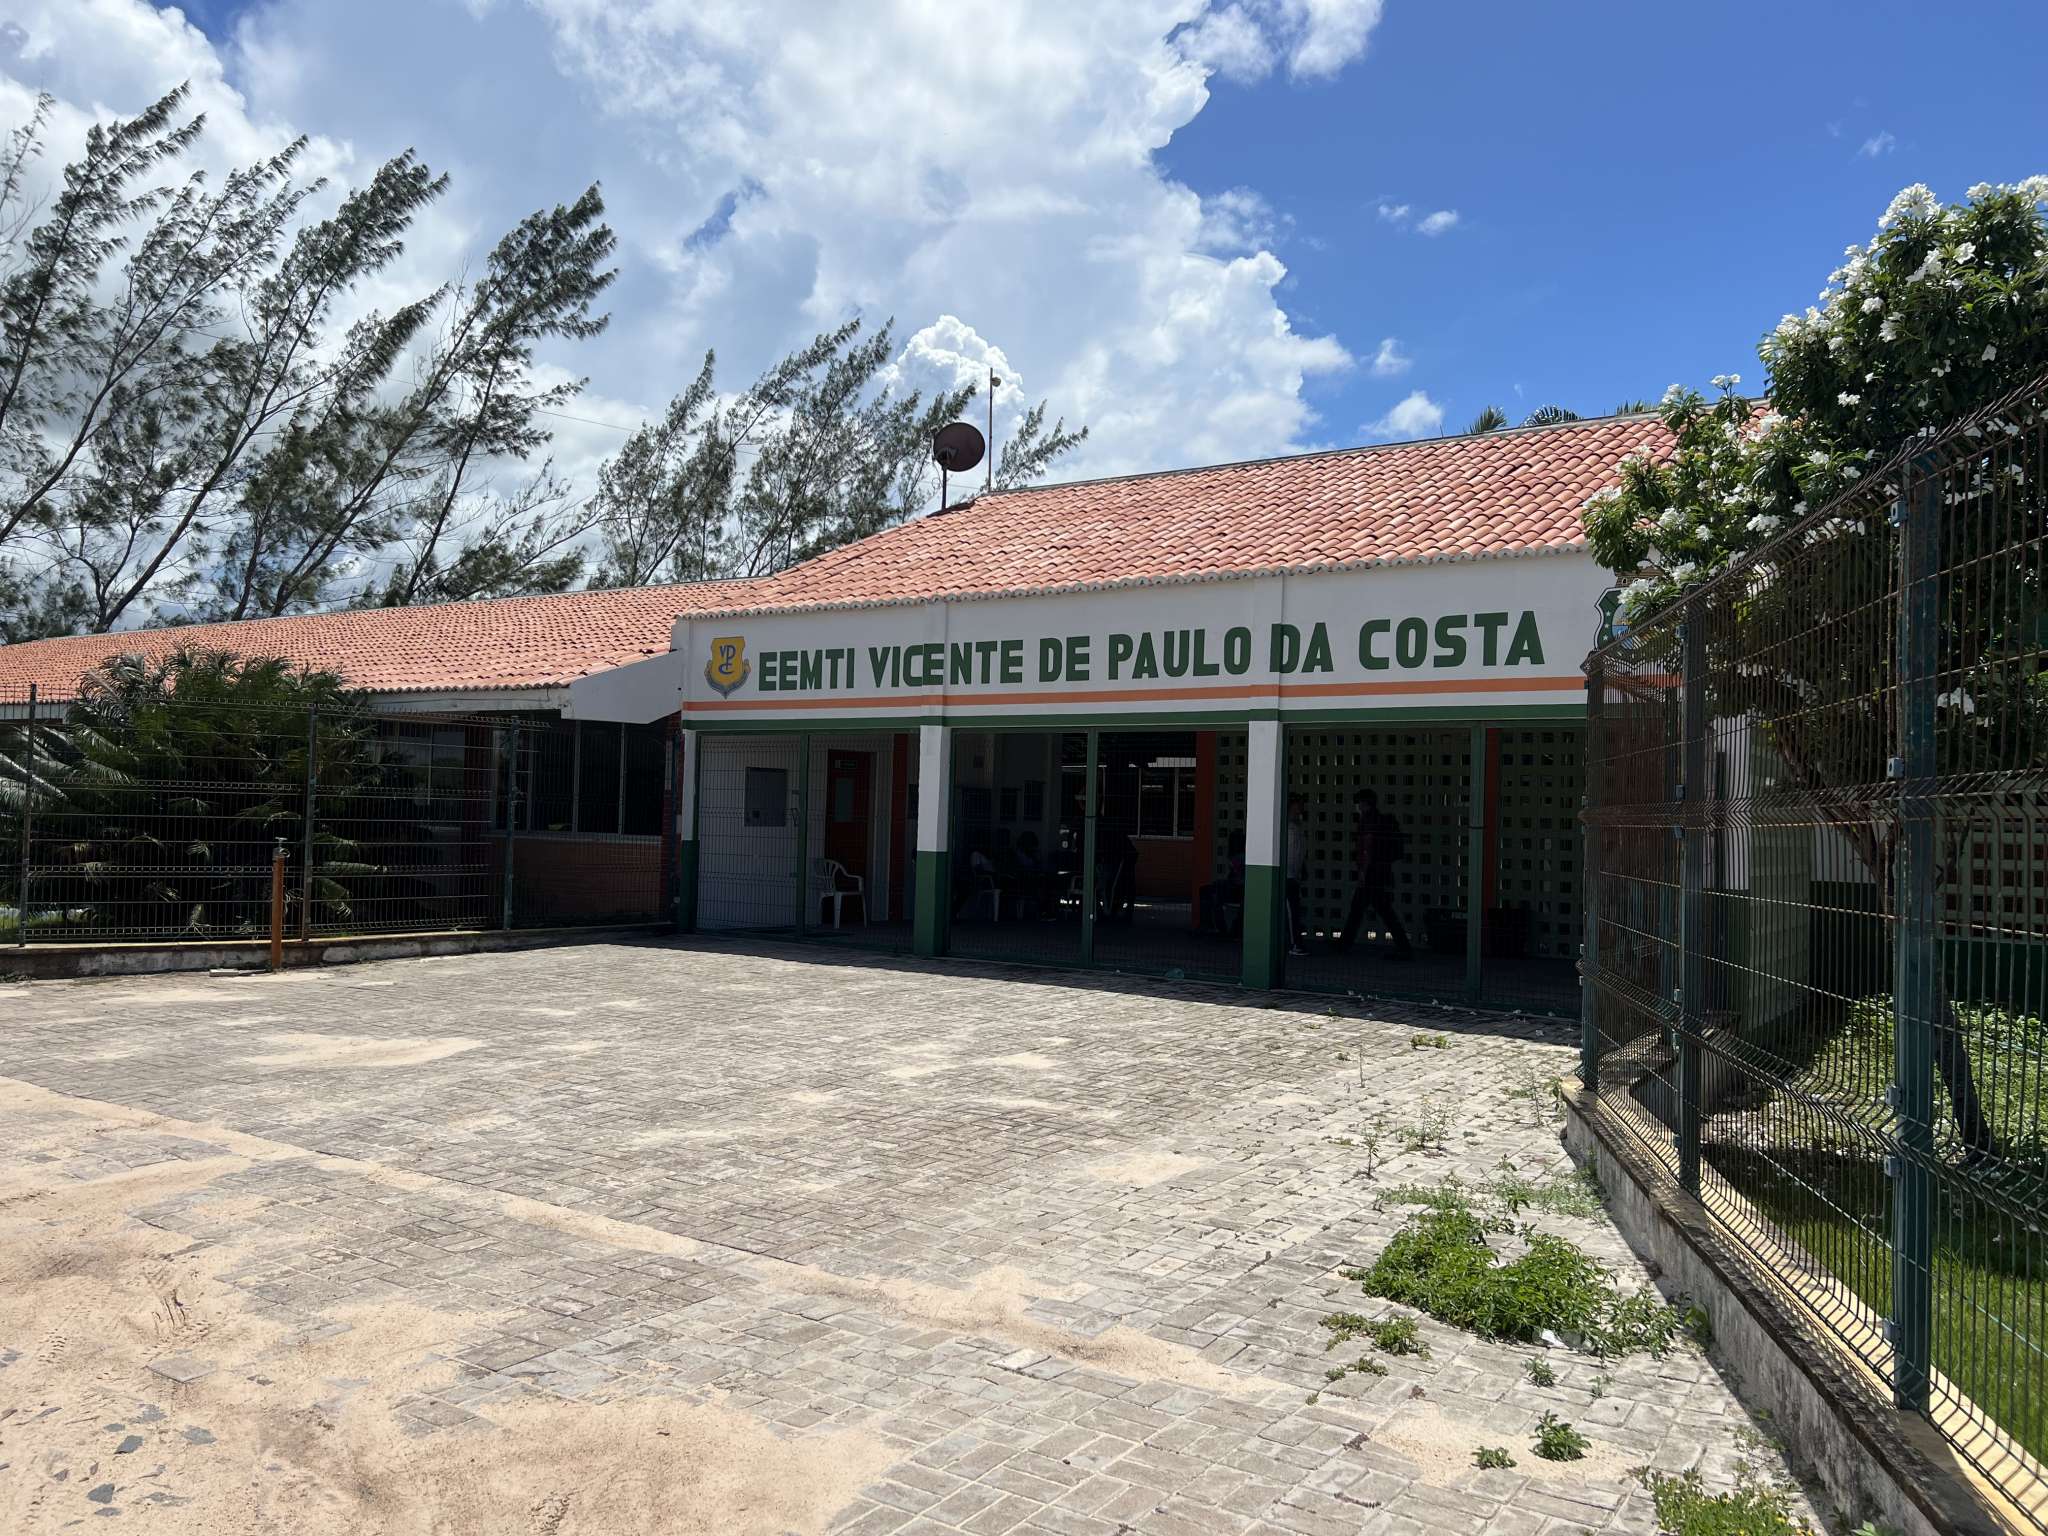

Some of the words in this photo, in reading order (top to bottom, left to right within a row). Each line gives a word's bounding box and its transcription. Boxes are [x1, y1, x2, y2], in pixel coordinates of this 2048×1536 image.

[758, 648, 855, 692] EEMTI
[868, 639, 1024, 689] VICENTE
[1039, 636, 1090, 683] DE
[1108, 627, 1252, 681] PAULO
[1269, 622, 1334, 674] DA
[1358, 610, 1546, 671] COSTA
